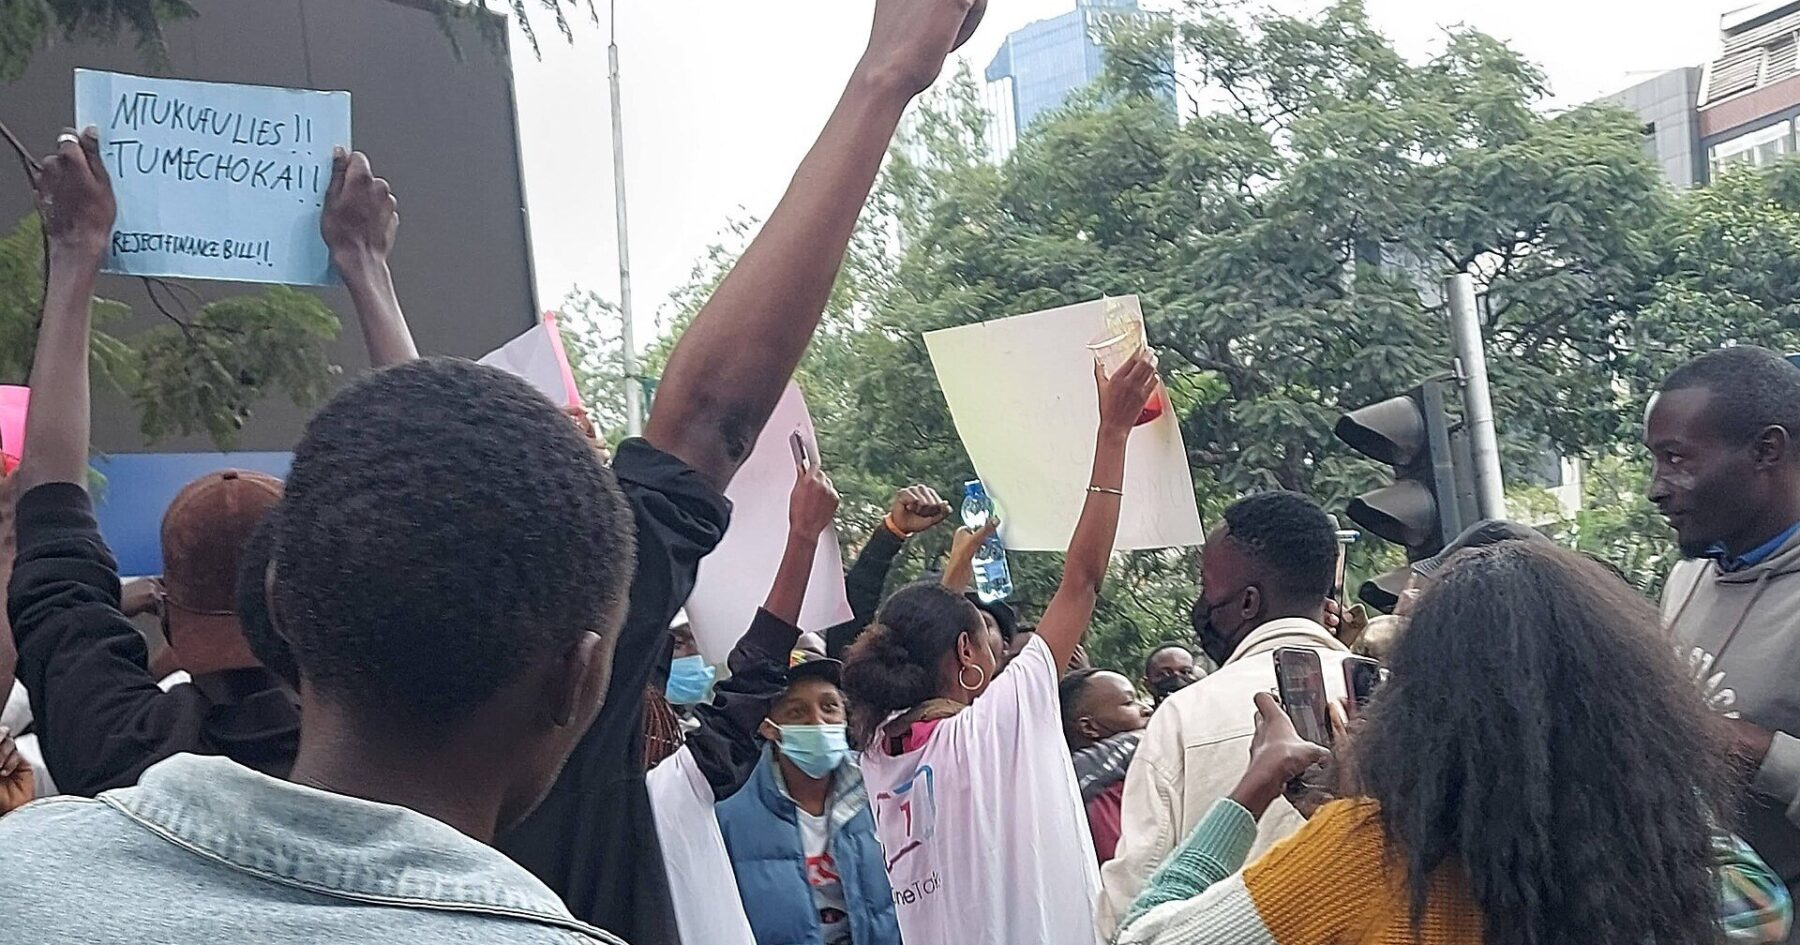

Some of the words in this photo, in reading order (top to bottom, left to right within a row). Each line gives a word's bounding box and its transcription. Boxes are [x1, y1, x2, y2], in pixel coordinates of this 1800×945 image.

[111, 92, 232, 136] MTUKUFU
[232, 114, 285, 146] LIES
[109, 140, 322, 208] TUMECHOKA!!
[223, 239, 273, 267] BILL!!
